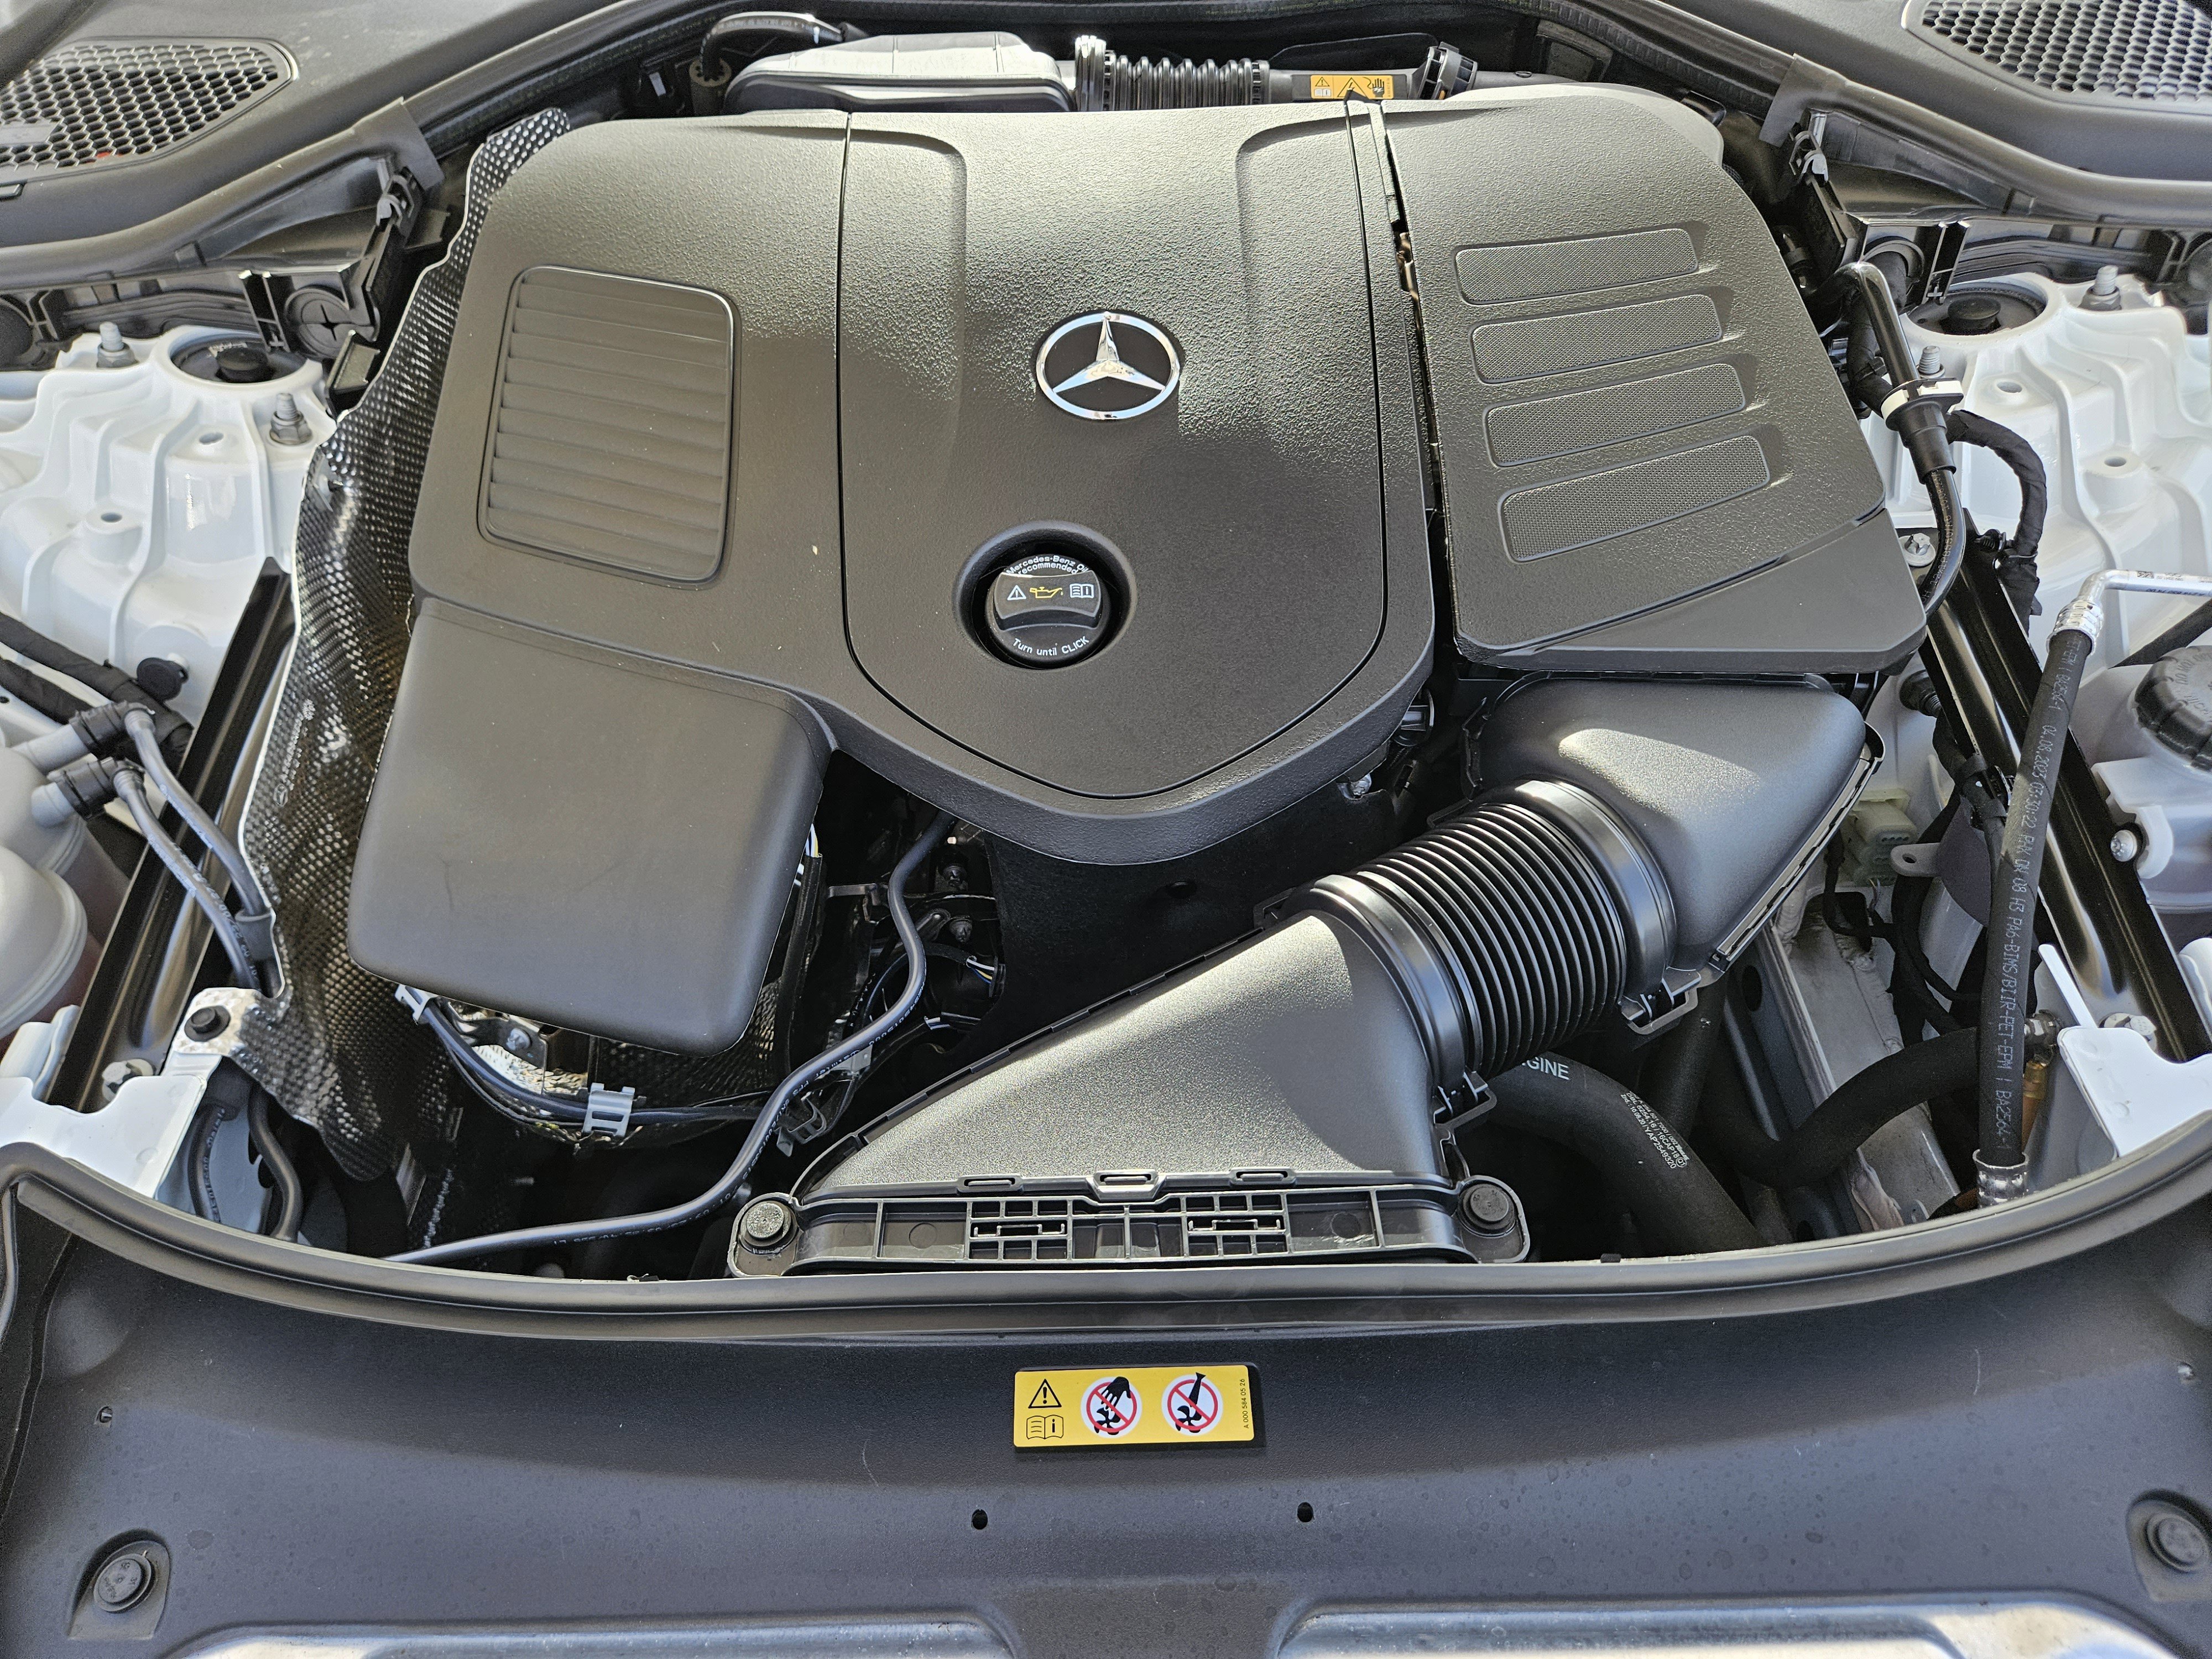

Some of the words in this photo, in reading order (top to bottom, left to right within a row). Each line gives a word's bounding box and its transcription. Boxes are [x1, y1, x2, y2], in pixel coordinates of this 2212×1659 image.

[1006, 555, 1075, 574] Mercedes-Benz
[1018, 562, 1079, 575] recommended
[1012, 638, 1033, 654] Turn
[1036, 647, 1057, 656] until
[1061, 636, 1089, 654] CLICK
[2020, 780, 2044, 828] 03:30:22
[2010, 877, 2028, 893] 08
[1645, 1126, 1677, 1169] YAP2549320
[1657, 1132, 1680, 1159] 16CAP18
[1239, 1378, 1245, 1386] 26
[1240, 1388, 1246, 1396] 05
